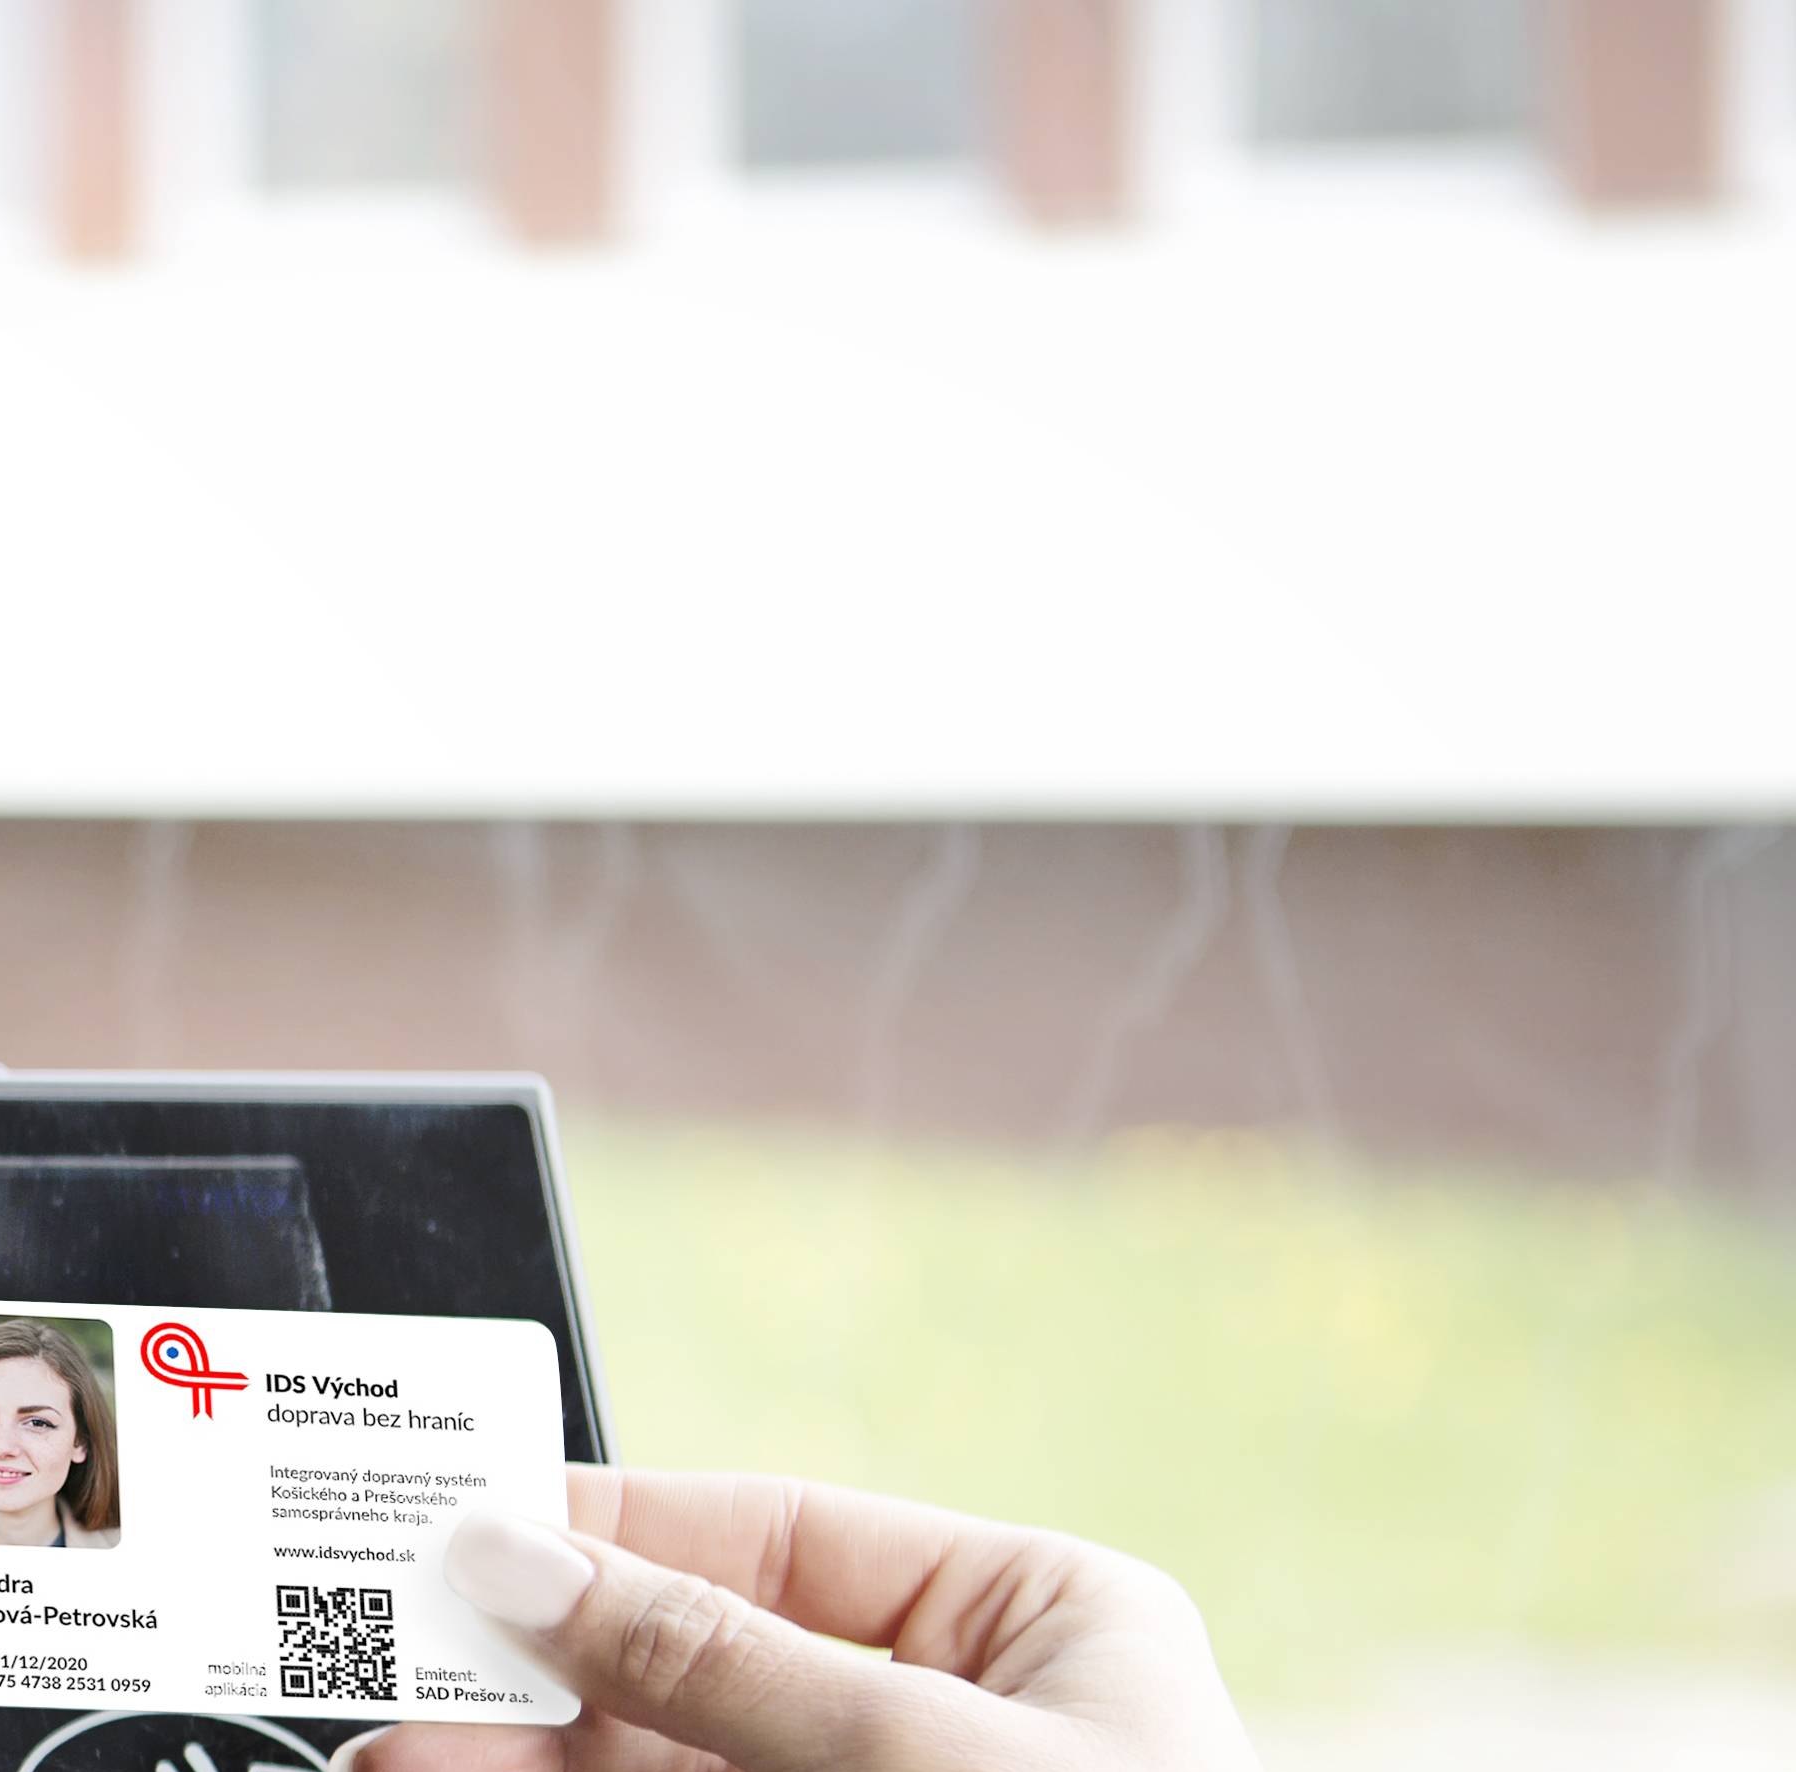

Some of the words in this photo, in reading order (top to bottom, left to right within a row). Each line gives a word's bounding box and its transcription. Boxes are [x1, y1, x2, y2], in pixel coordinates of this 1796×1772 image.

[266, 1373, 306, 1394] IDS
[312, 1376, 398, 1400] Východ
[267, 1403, 355, 1428] doprava
[363, 1408, 401, 1428] bez
[408, 1410, 474, 1431] hraníc
[271, 1465, 358, 1484] Integrovaný
[362, 1469, 431, 1487] dopravný
[435, 1474, 486, 1488] systém
[271, 1486, 347, 1501] Košického
[351, 1492, 359, 1502] a
[365, 1489, 457, 1506] Prešovského
[272, 1507, 389, 1522] samosprávneho
[274, 1546, 415, 1563] www.idsvychod.sk
[416, 1667, 477, 1682] Emitent:
[21, 1675, 61, 1690] 4738
[66, 1677, 106, 1691] 2531
[111, 1678, 151, 1693] 0959
[416, 1686, 449, 1700] SAD
[454, 1687, 506, 1702] Prešov
[509, 1693, 534, 1704] a.s.
